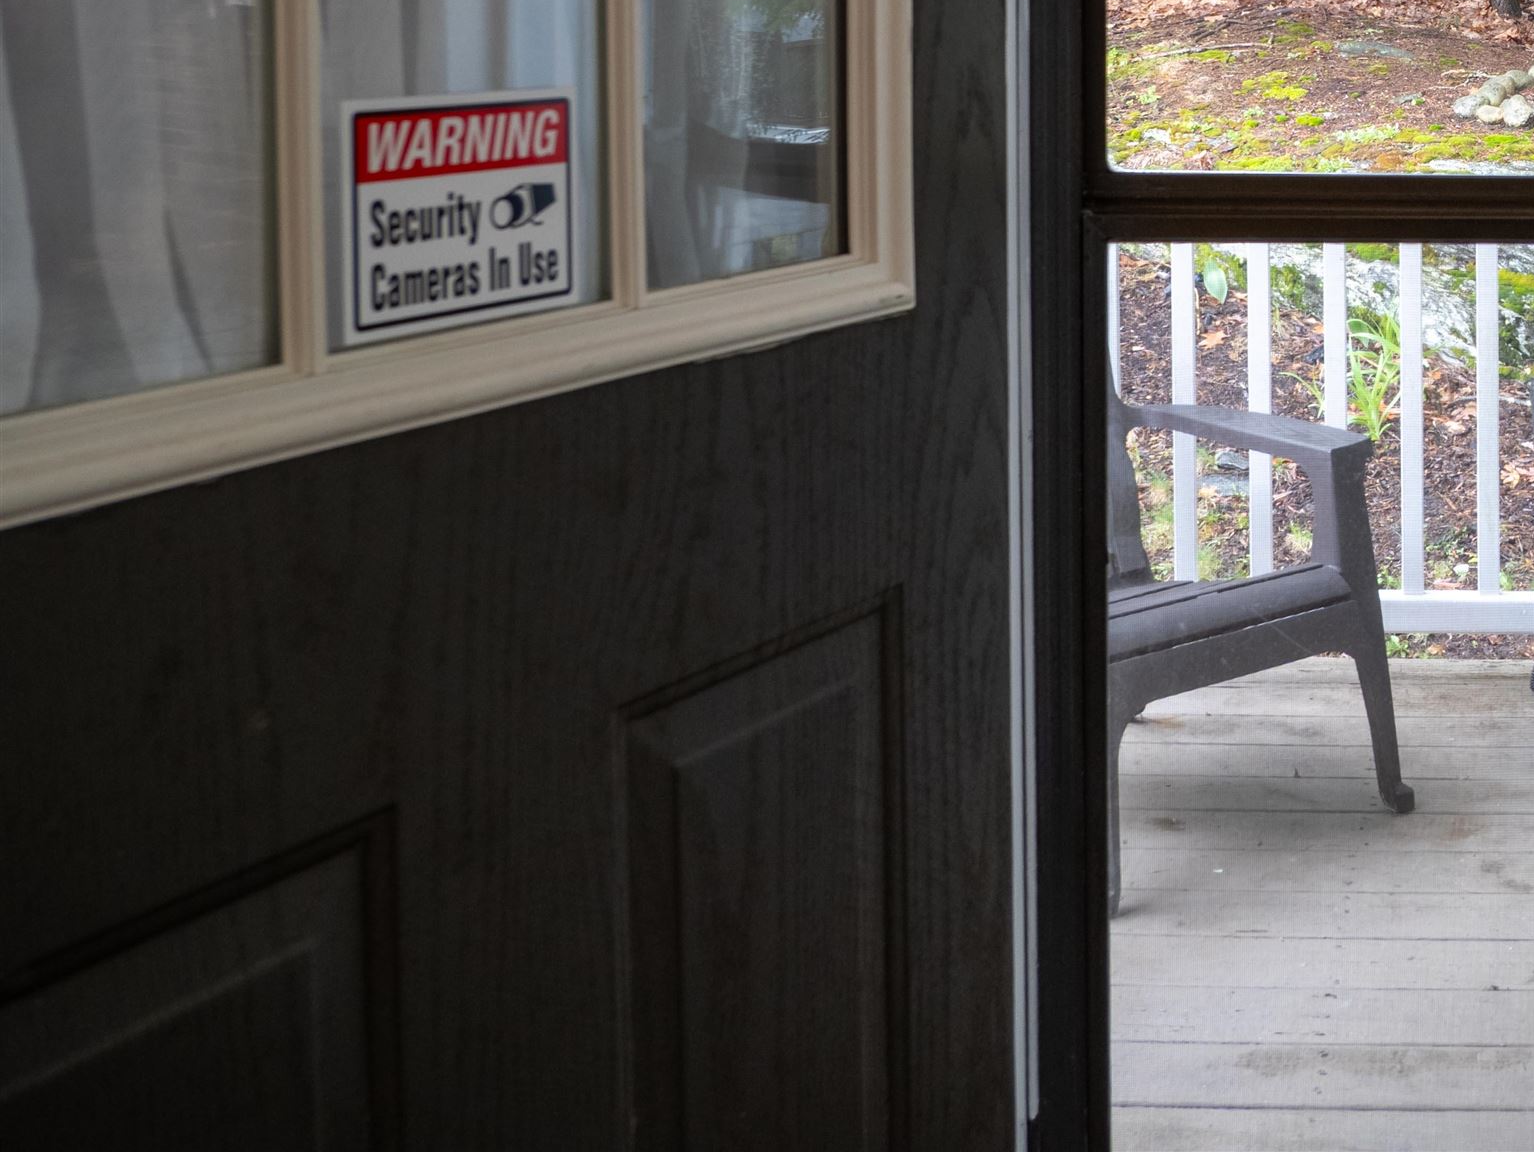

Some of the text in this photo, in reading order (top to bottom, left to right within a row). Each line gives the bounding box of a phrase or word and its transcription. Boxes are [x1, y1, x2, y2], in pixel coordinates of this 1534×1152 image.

[367, 109, 560, 174] WARNING
[370, 191, 481, 247] Security
[371, 242, 558, 311] Cameras In Use
